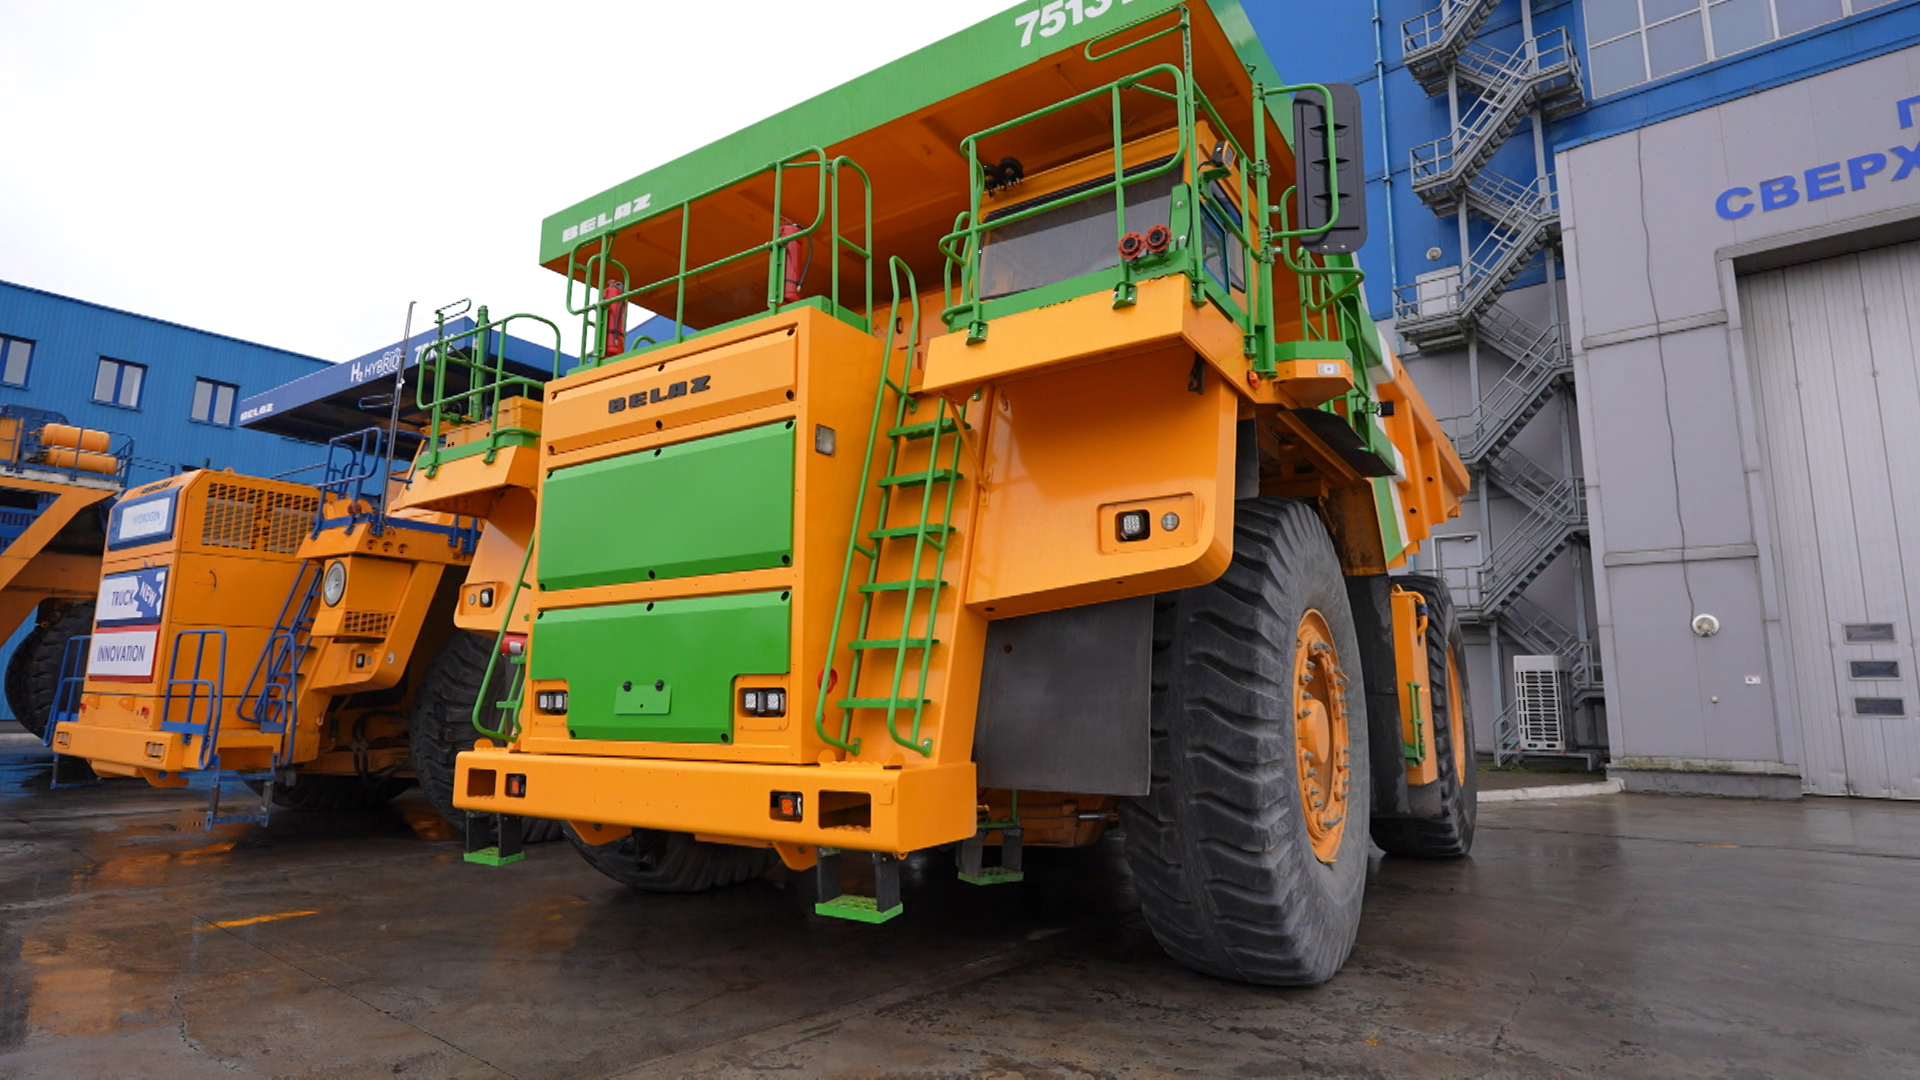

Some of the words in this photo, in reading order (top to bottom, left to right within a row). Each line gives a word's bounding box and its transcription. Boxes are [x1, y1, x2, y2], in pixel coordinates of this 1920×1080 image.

[1015, 0, 1135, 47] 7513
[562, 193, 651, 243] BELAZ
[608, 375, 711, 413] BELAZ
[111, 589, 135, 606] TRUCK
[139, 581, 157, 608] NEW
[97, 644, 146, 662] INNOVATION
